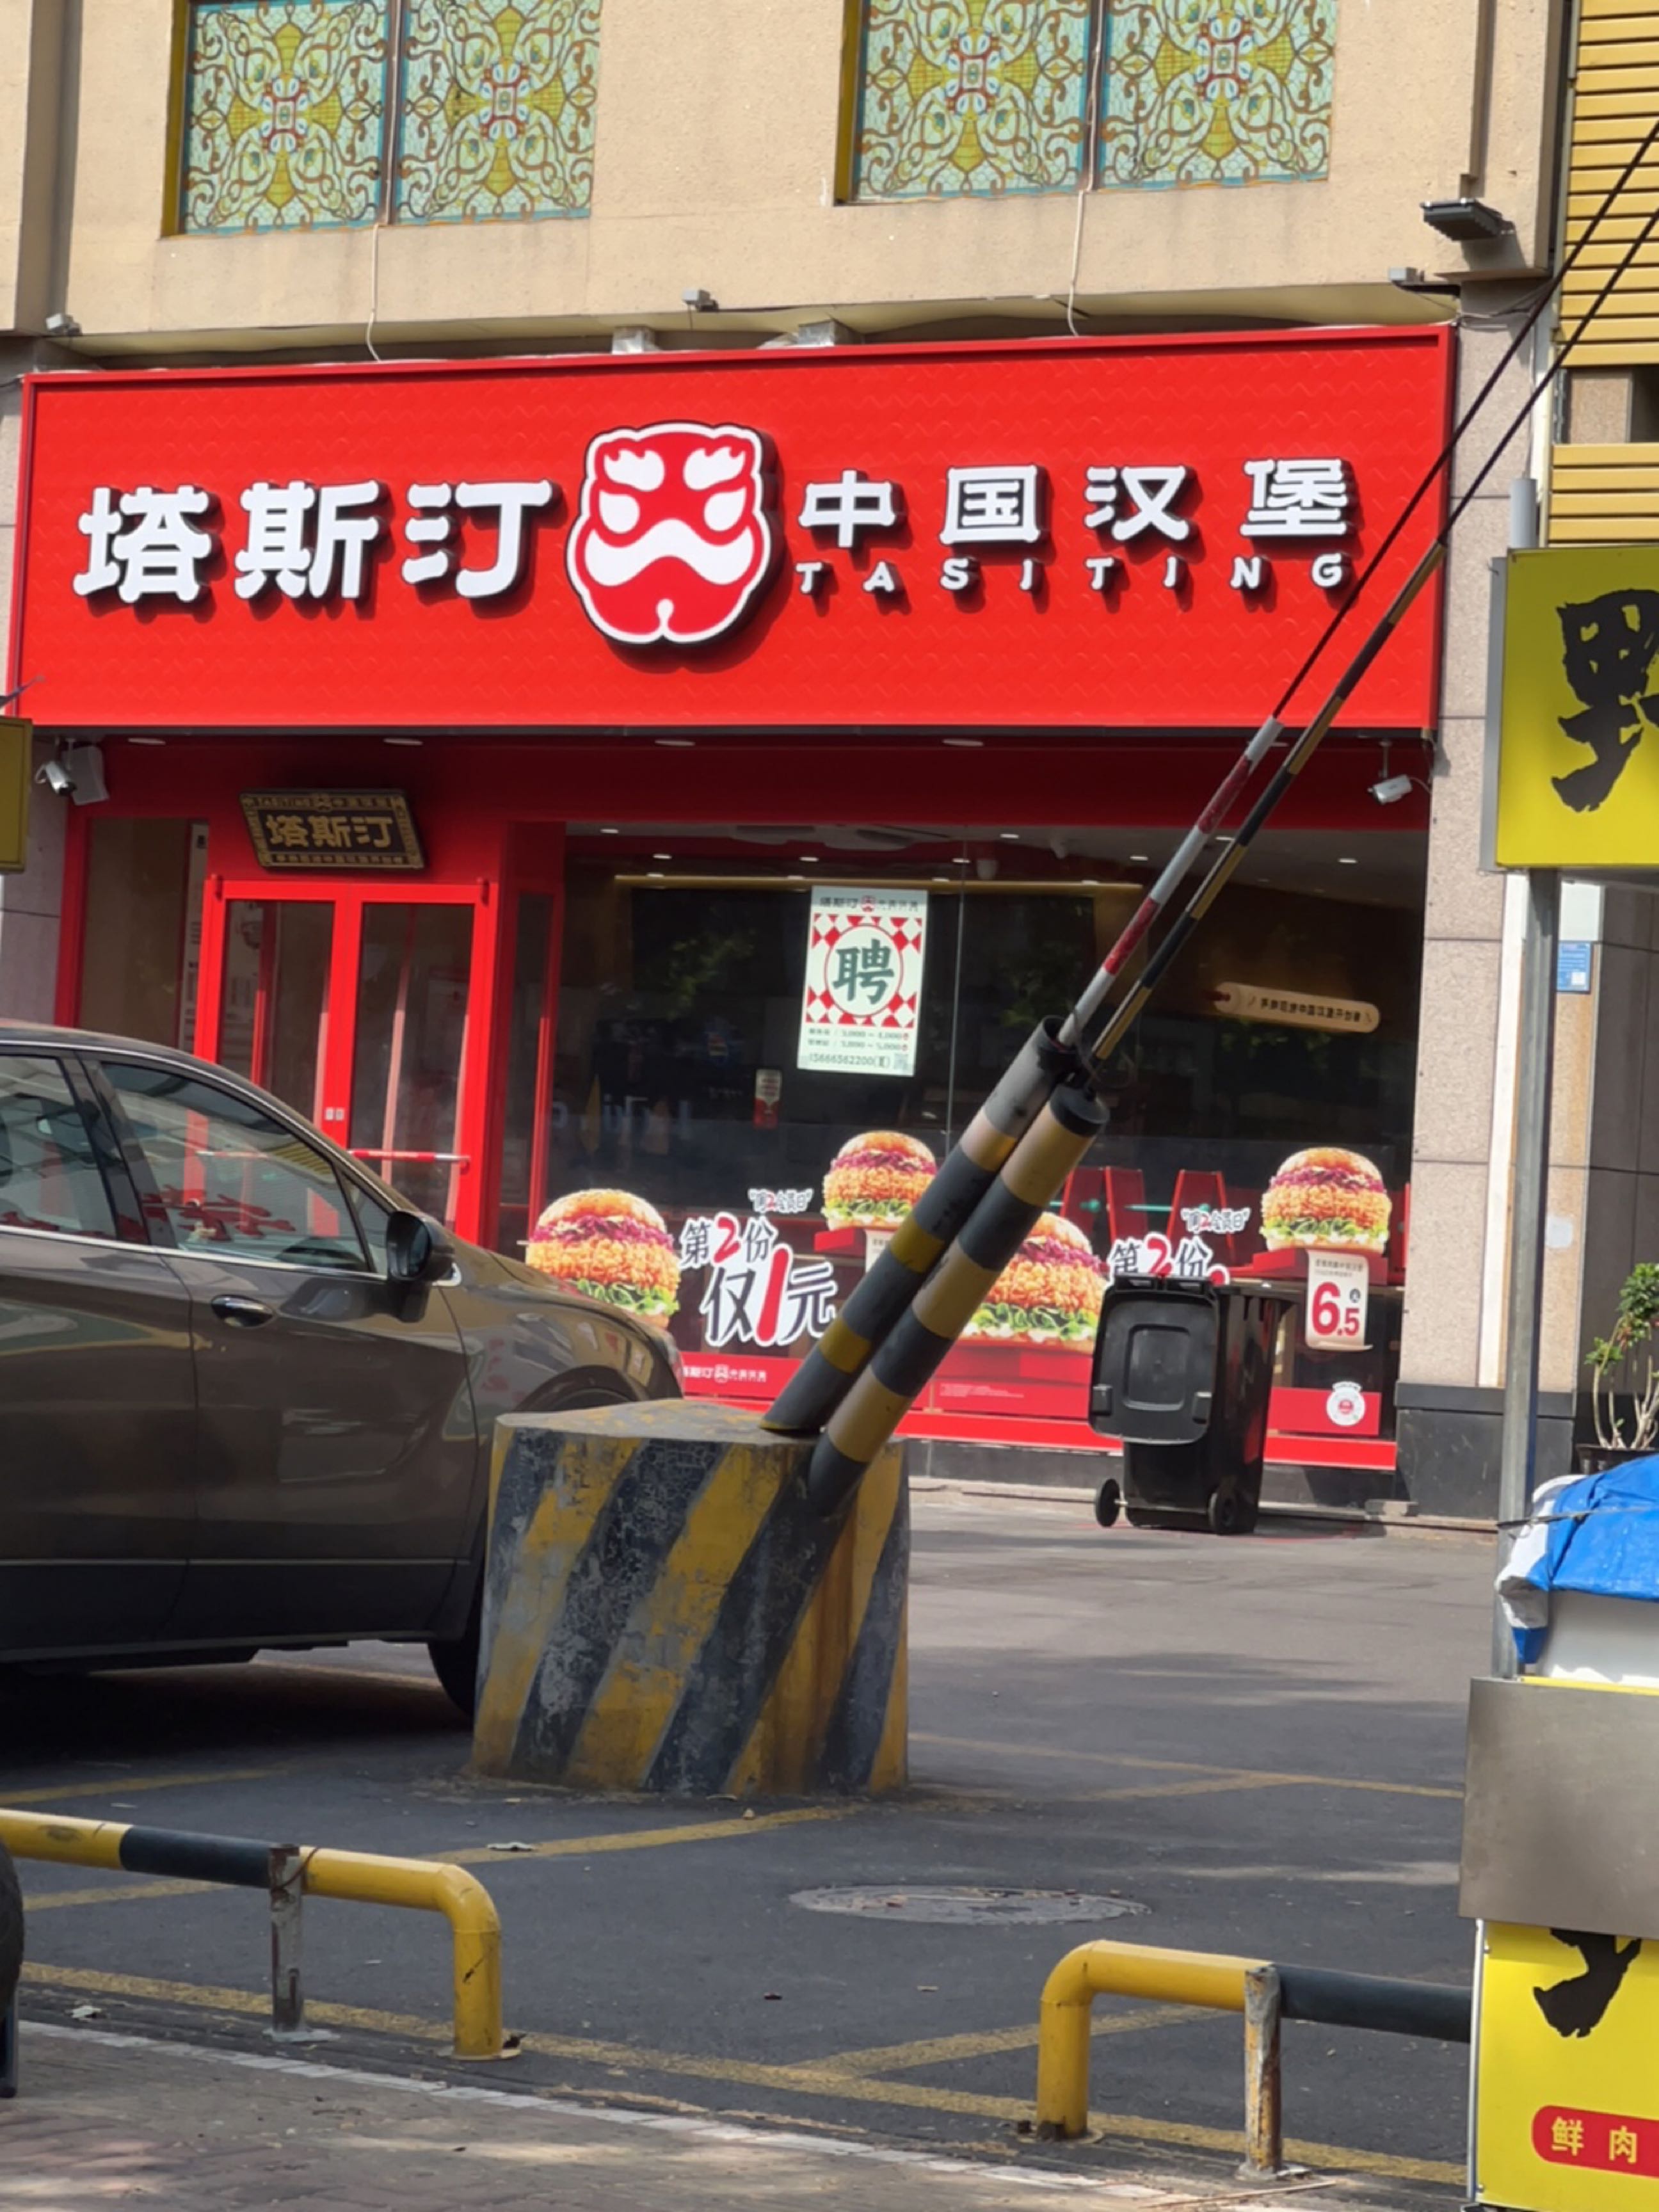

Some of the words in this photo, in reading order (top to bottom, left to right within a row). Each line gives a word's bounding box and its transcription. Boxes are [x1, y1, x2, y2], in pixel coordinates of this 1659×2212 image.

[73, 479, 553, 603] 塔斯汀
[797, 457, 1348, 548] 中国汉堡
[795, 552, 1343, 594] TASITING
[266, 814, 393, 848] 塔斯汀
[832, 938, 895, 1005] 聘
[680, 1215, 774, 1267] 第2份
[1112, 1237, 1210, 1276] 第2份
[701, 1248, 836, 1343] 仅1元
[1312, 1281, 1360, 1336] 6.5
[1551, 2115, 1639, 2164] 鲜肉
